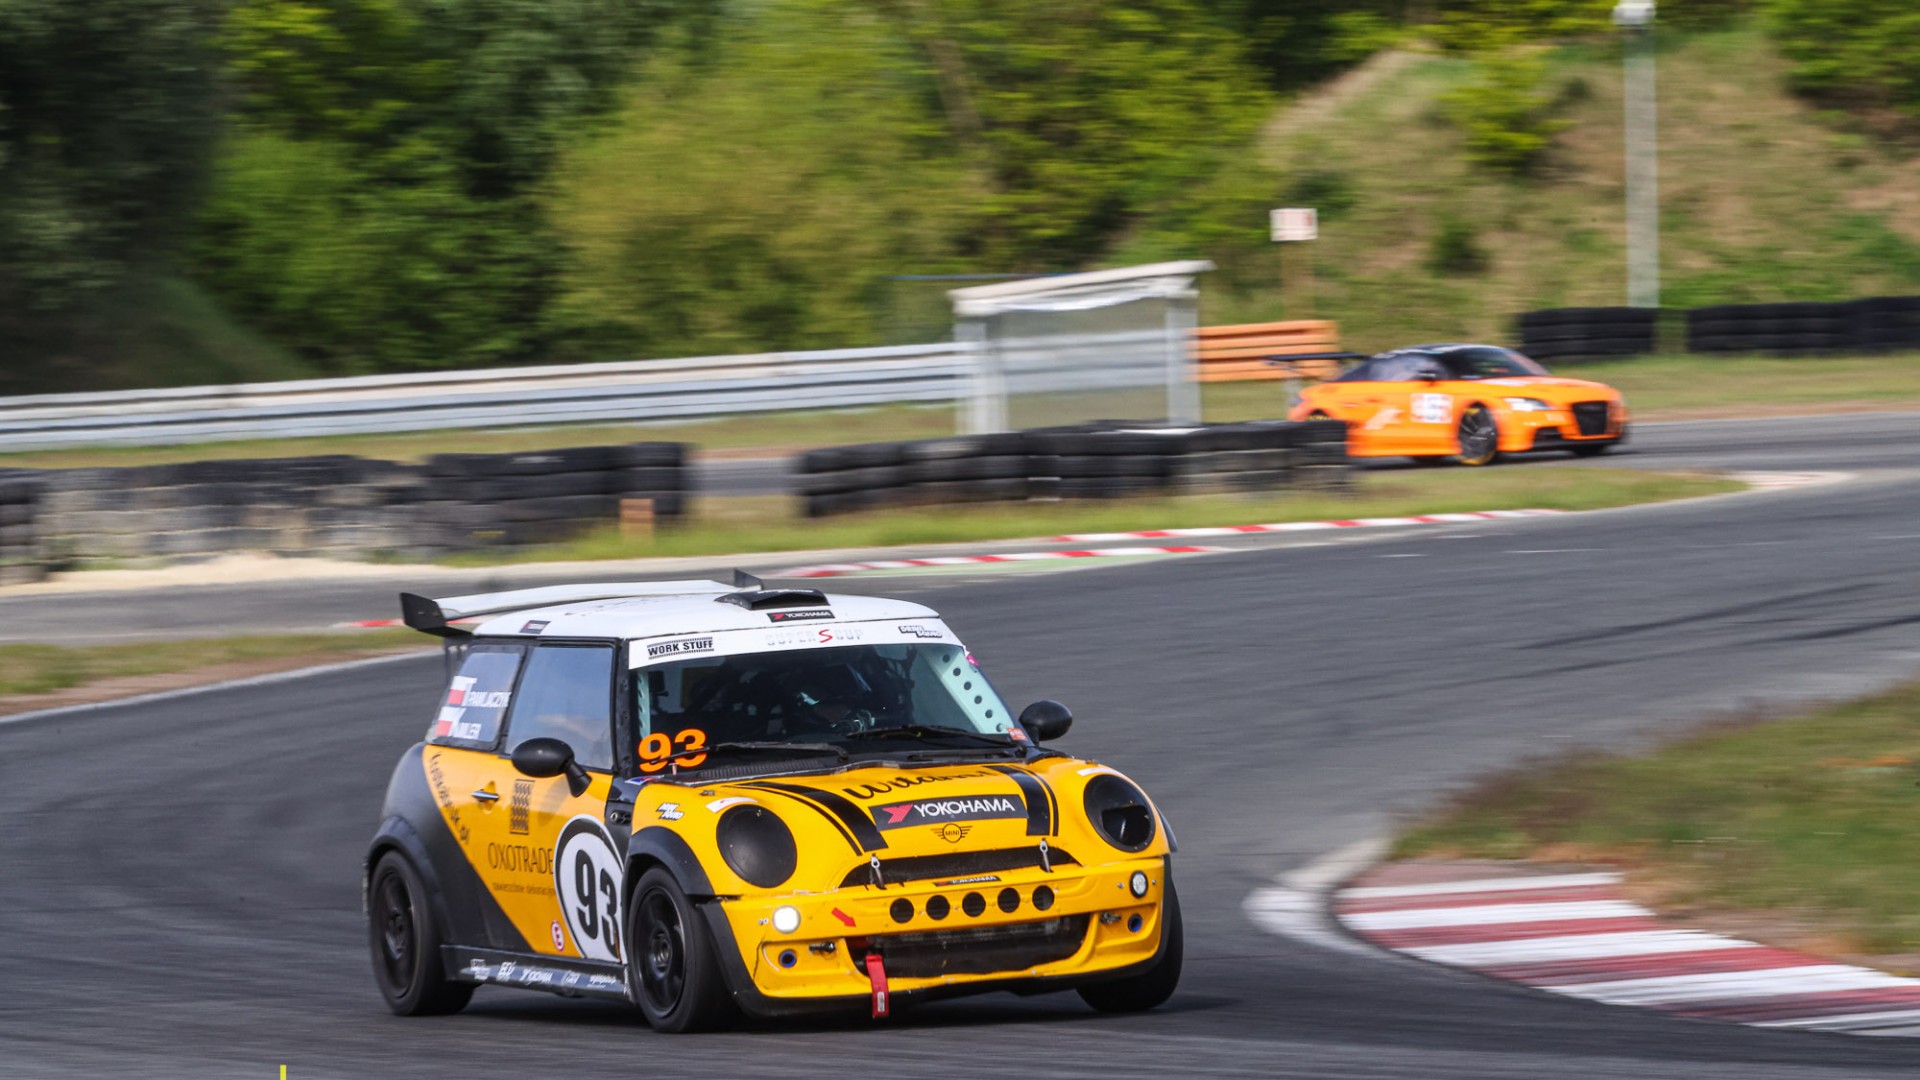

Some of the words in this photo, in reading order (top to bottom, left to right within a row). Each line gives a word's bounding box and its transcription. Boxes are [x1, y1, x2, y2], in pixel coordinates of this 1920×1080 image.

[648, 643, 680, 656] WORK
[683, 640, 713, 651] STUFF
[818, 629, 833, 643] S
[638, 728, 707, 773] 93
[913, 798, 1015, 818] YOKOHAMA
[488, 842, 554, 875] OXOTRADE
[575, 849, 620, 960] 93
